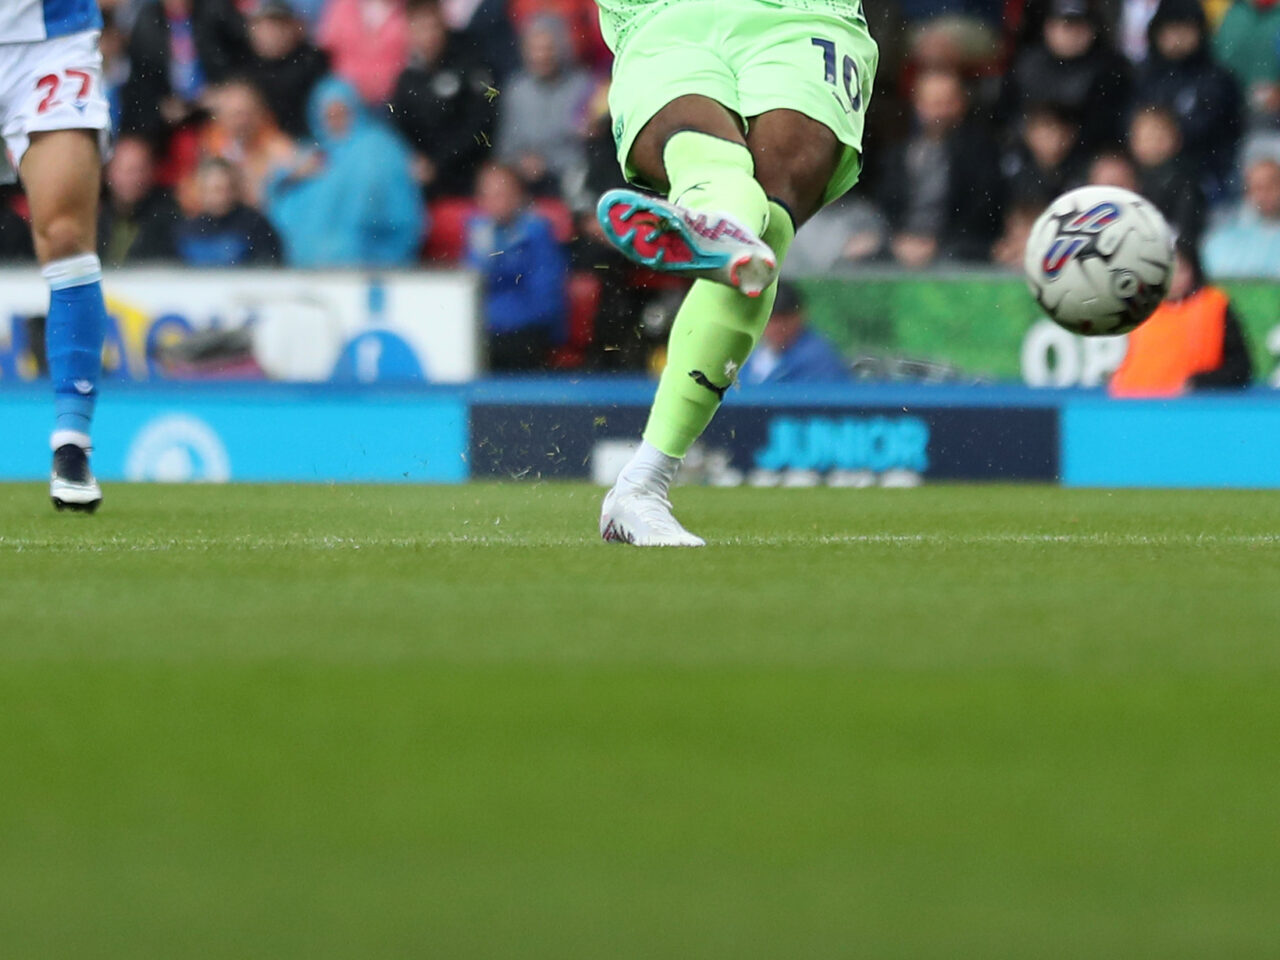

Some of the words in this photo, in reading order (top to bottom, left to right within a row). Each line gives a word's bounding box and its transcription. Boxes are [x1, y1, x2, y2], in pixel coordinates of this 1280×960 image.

[35, 68, 91, 114] 27
[811, 37, 861, 112] 10
[754, 416, 930, 471] JUNIOR
